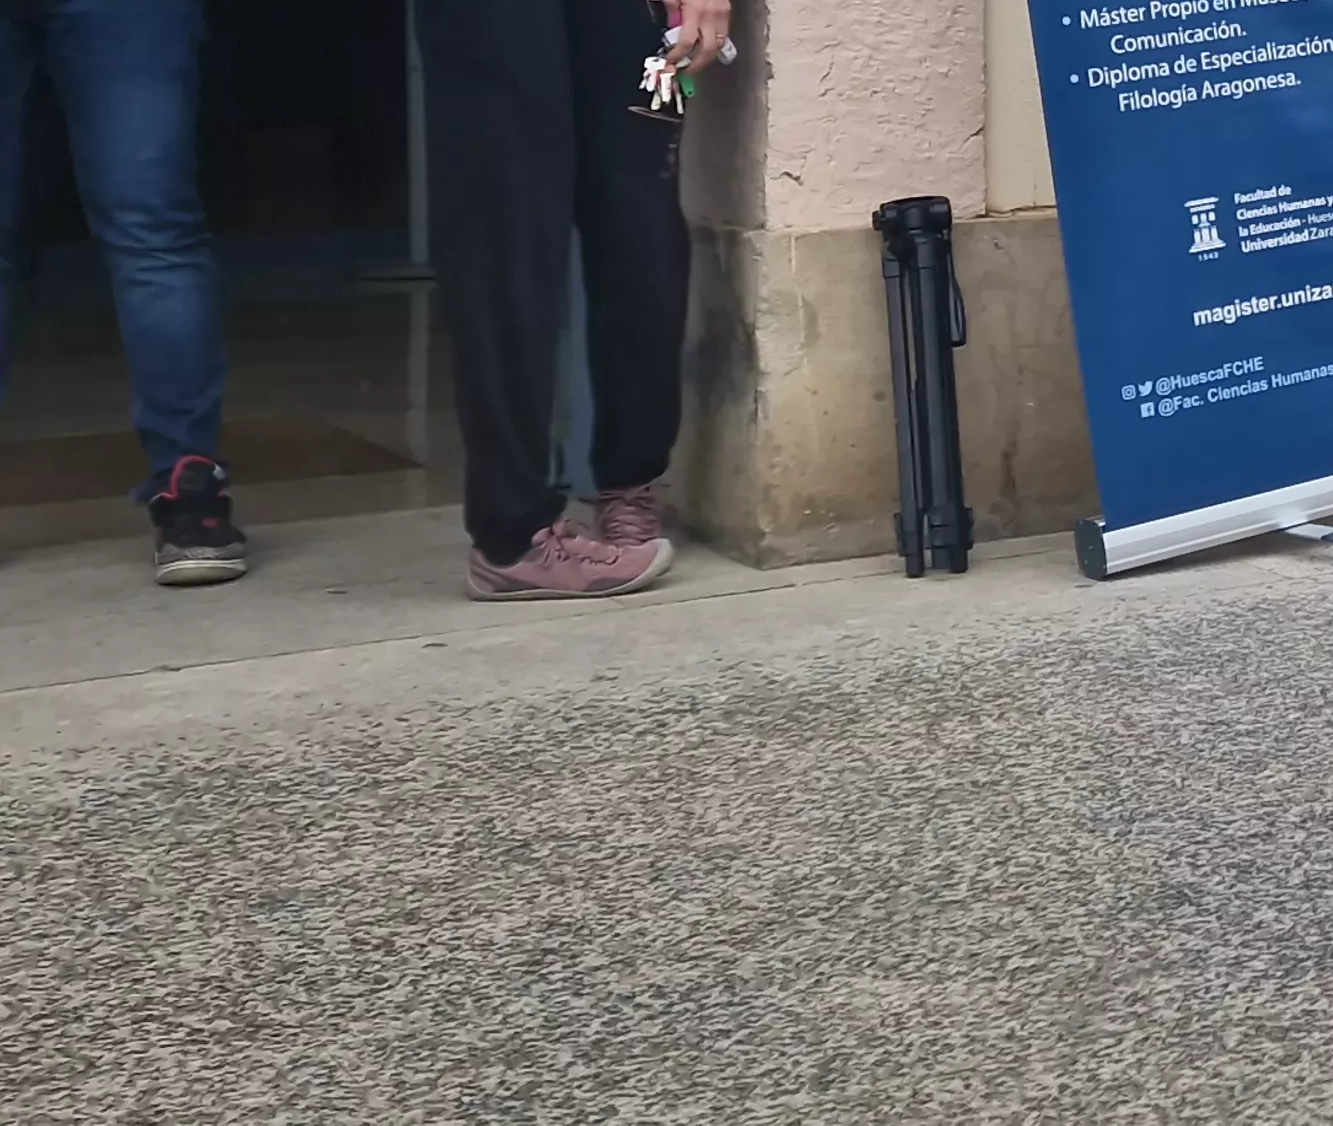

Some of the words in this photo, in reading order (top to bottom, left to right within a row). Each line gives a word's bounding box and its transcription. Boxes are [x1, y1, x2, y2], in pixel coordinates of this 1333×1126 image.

[1081, 7, 1146, 28] Máster
[1111, 22, 1247, 54] Comunicación.
[1088, 63, 1169, 93] Diploma
[1174, 55, 1197, 74] de
[1201, 36, 1333, 72] Especialización
[1119, 84, 1197, 111] Filología
[1202, 73, 1301, 99] Aragonesa.
[1235, 186, 1277, 203] Facultad
[1278, 185, 1291, 196] de
[1237, 205, 1278, 220] Ciencias
[1279, 197, 1326, 213] Humanas
[1327, 196, 1333, 207] y
[1239, 227, 1248, 236] la
[1249, 217, 1301, 235] Educación
[1241, 231, 1309, 252] Universidad
[1156, 357, 1264, 396] @HuescaFCHE
[1159, 396, 1204, 416] @Fac.
[1208, 380, 1268, 402] Ciencias
